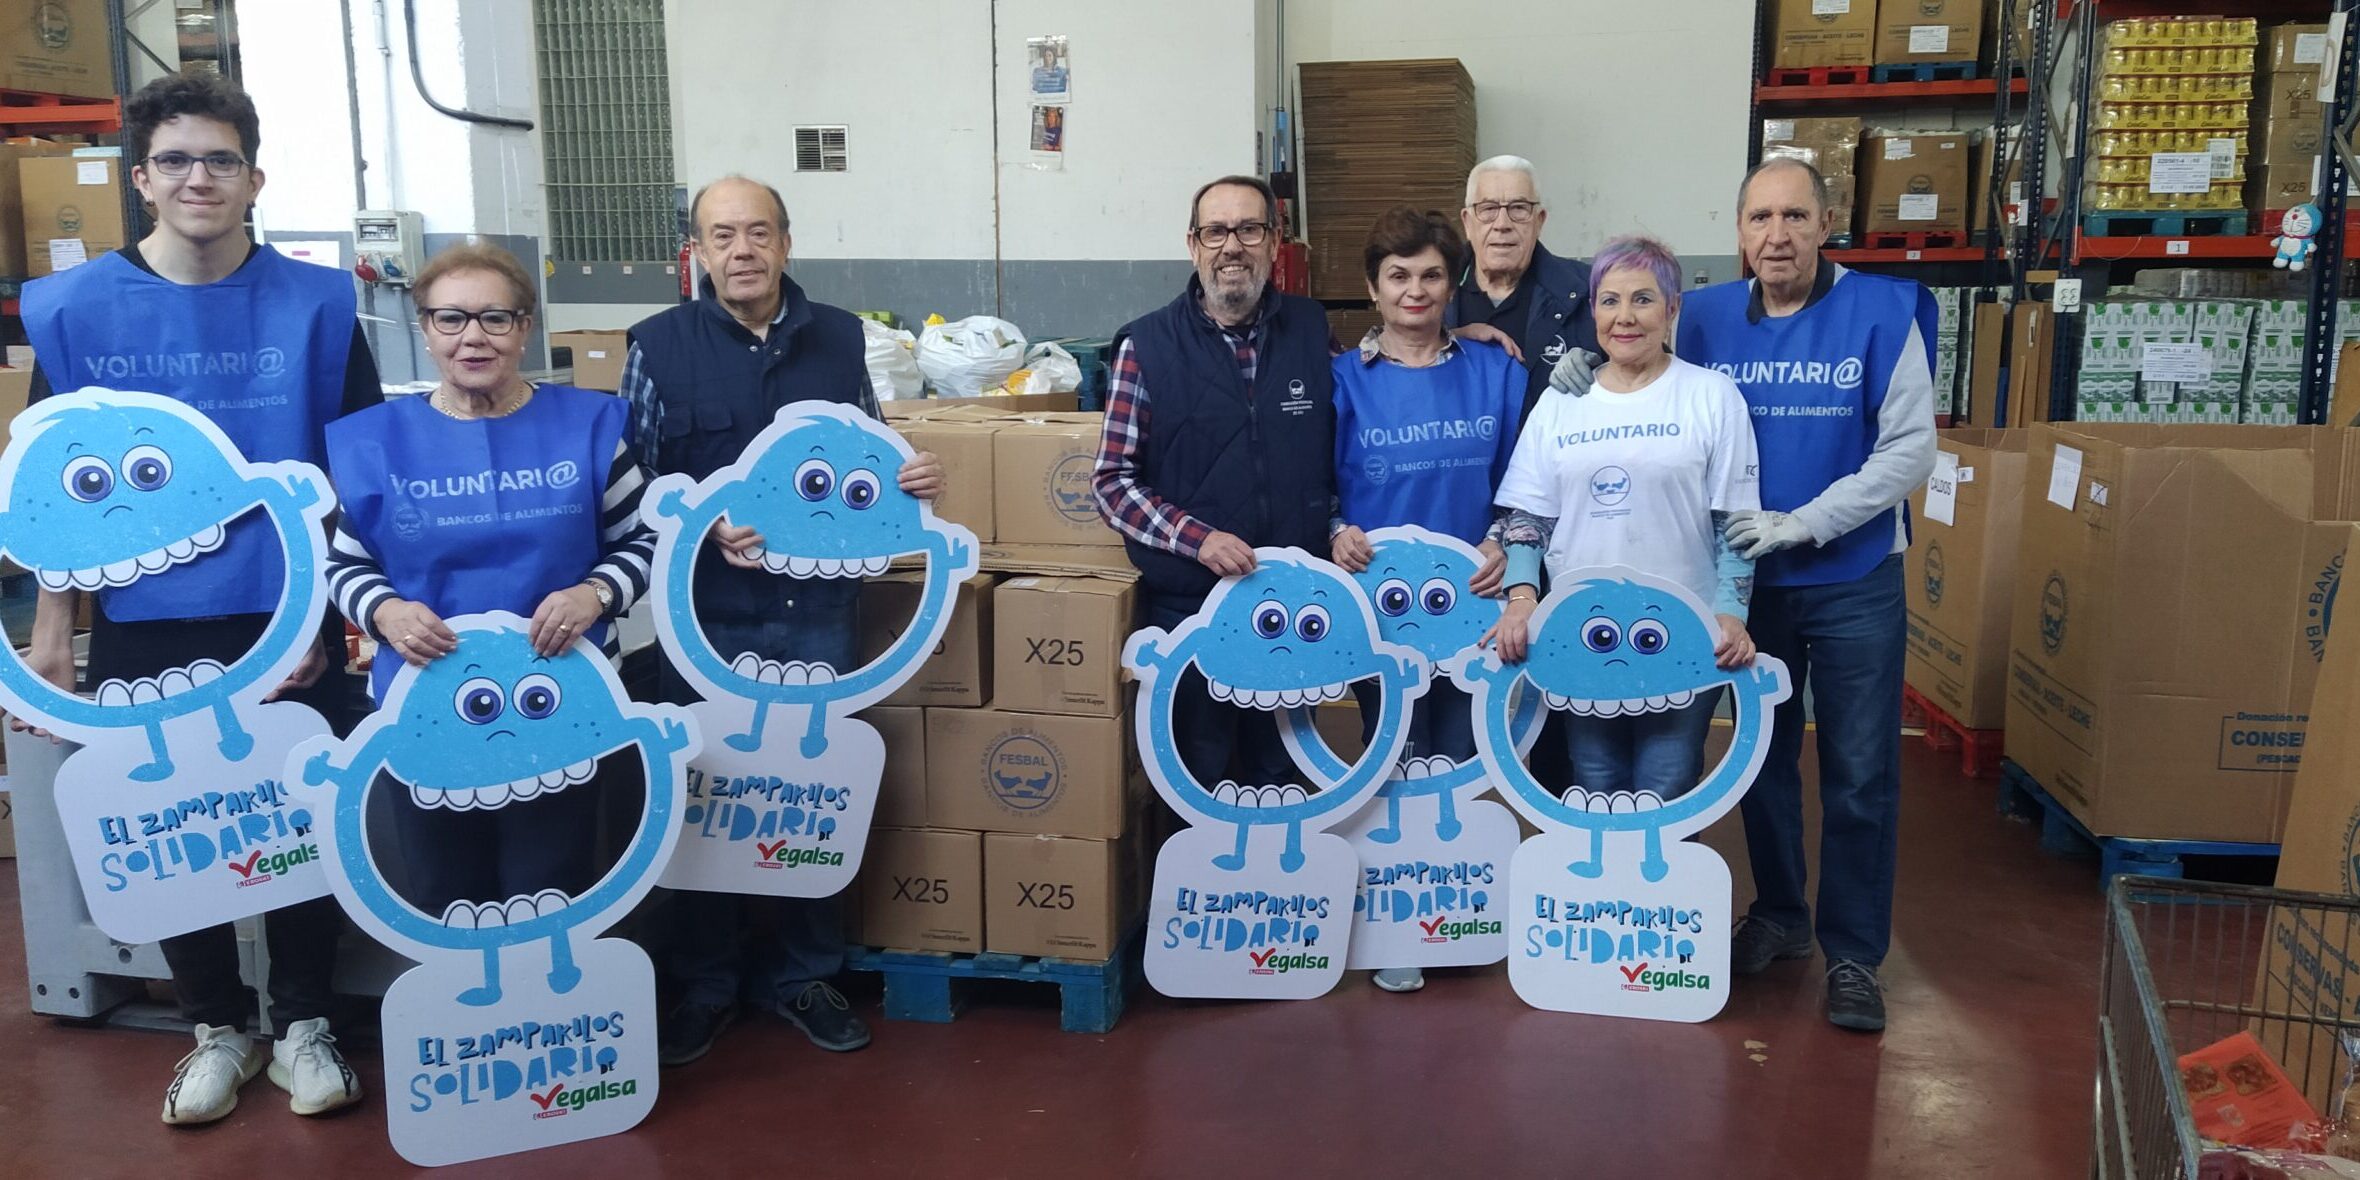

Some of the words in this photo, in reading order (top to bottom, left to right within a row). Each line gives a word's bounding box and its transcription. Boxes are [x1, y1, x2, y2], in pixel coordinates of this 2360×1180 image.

[2280, 181, 2307, 193] X25
[85, 346, 286, 379] VOLUNTARI@
[198, 400, 215, 410] DE
[218, 394, 288, 409] ALIMENTOS
[1771, 406, 1786, 417] DE
[1788, 406, 1854, 417] ALIMENTOS
[1358, 415, 1497, 449] VOLUNTARI@
[1557, 423, 1681, 449] VOLUNTARIO
[389, 460, 580, 500] VOLUNTARI@
[1061, 471, 1091, 482] FESB
[437, 513, 492, 527] BANCOS
[515, 503, 583, 520] ALIMENTOS
[2309, 555, 2344, 604] BANC
[1024, 637, 1084, 666] X25
[2231, 730, 2305, 747] CONSE
[1000, 754, 1048, 766] FESBAL
[710, 776, 850, 811] ZAMPAKILOS
[98, 816, 137, 845] EL
[138, 779, 289, 837] ZAMPAKIL
[685, 800, 836, 841] OLIDARIO
[295, 822, 312, 837] DE
[101, 808, 313, 892] SOLIDARIO
[229, 843, 320, 879] Vegals
[757, 839, 844, 868] Vegalsa
[1365, 861, 1494, 886] ZAMPAKILOS
[892, 876, 949, 904] X25
[1016, 881, 1075, 910] X25
[1177, 887, 1198, 915] EL
[1203, 890, 1330, 919] ZAMPAKILOS
[1354, 885, 1488, 923] OLIDARIO
[1419, 915, 1502, 940] Vegalsa
[1535, 894, 1560, 922] EL
[1564, 900, 1702, 934] ZAMPAKILOS
[1164, 915, 1320, 952] SOLIDARIO
[1304, 936, 1316, 947] DE
[1526, 924, 1696, 965] SOLIDARIO
[1250, 947, 1329, 974] Vegalsa
[1679, 953, 1692, 964] DE
[1620, 962, 1710, 992] Vegalsa
[418, 1037, 450, 1067] EL
[456, 1011, 625, 1060] ZAMPAKILOS
[410, 1046, 618, 1112] SOLIDARIO
[600, 1061, 616, 1075] DE
[530, 1079, 637, 1111] Vegalsa
